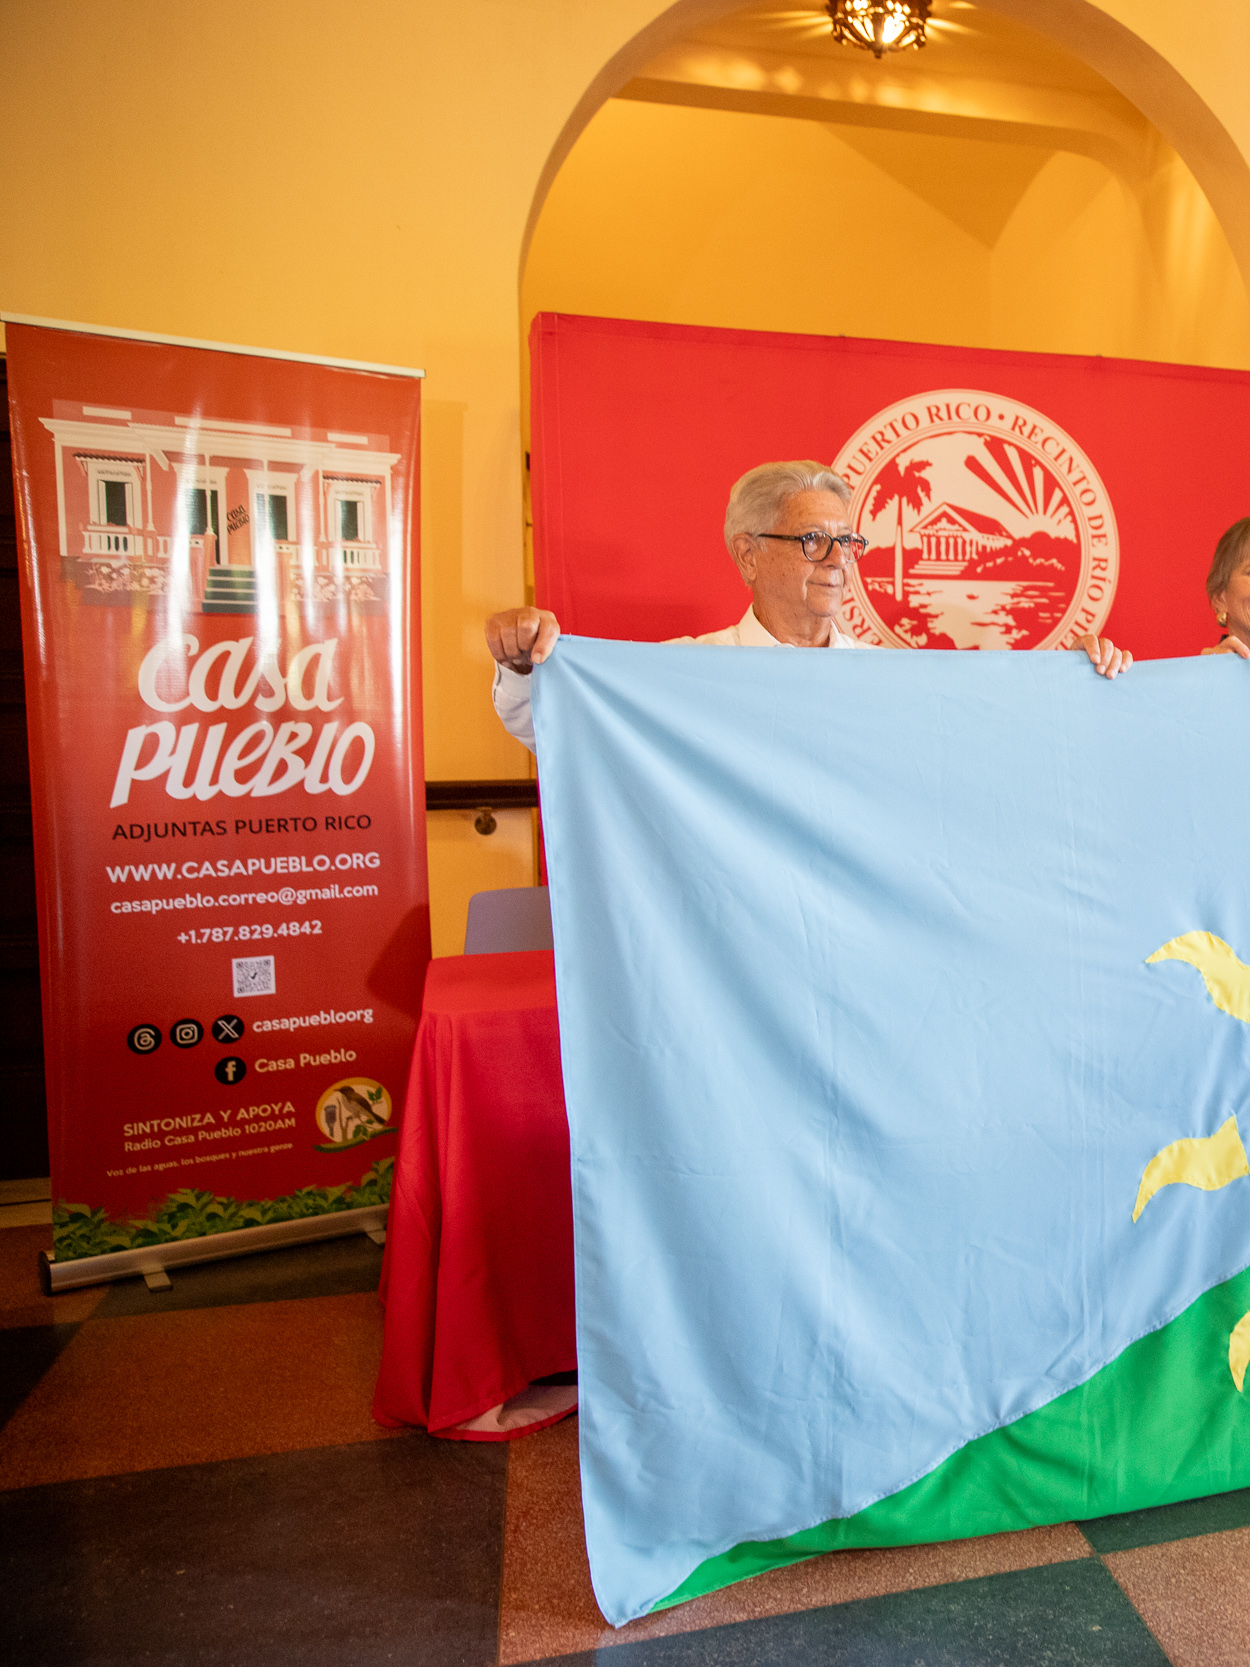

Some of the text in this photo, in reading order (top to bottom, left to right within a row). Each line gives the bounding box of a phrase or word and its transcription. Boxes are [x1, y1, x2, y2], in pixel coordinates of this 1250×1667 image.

[926, 402, 991, 424] RICO
[1010, 414, 1097, 507] RECINTO
[1087, 514, 1108, 547] DE
[1086, 556, 1112, 602] RÍO
[112, 814, 371, 842] ADJUNTAS PUERTO RICO
[105, 851, 381, 883] WWW.CASAPUEBLO.ORG
[110, 884, 379, 915] casapueblo.correo@gmail.com
[177, 919, 323, 944] +1.787.829.4842
[252, 1008, 374, 1033] casapuebloorg
[254, 1048, 357, 1073] Casa Pueblo
[123, 1101, 296, 1137] SINTONIZA Y APOYA
[124, 1117, 296, 1152] Radio Casa Pueblo 1020AM
